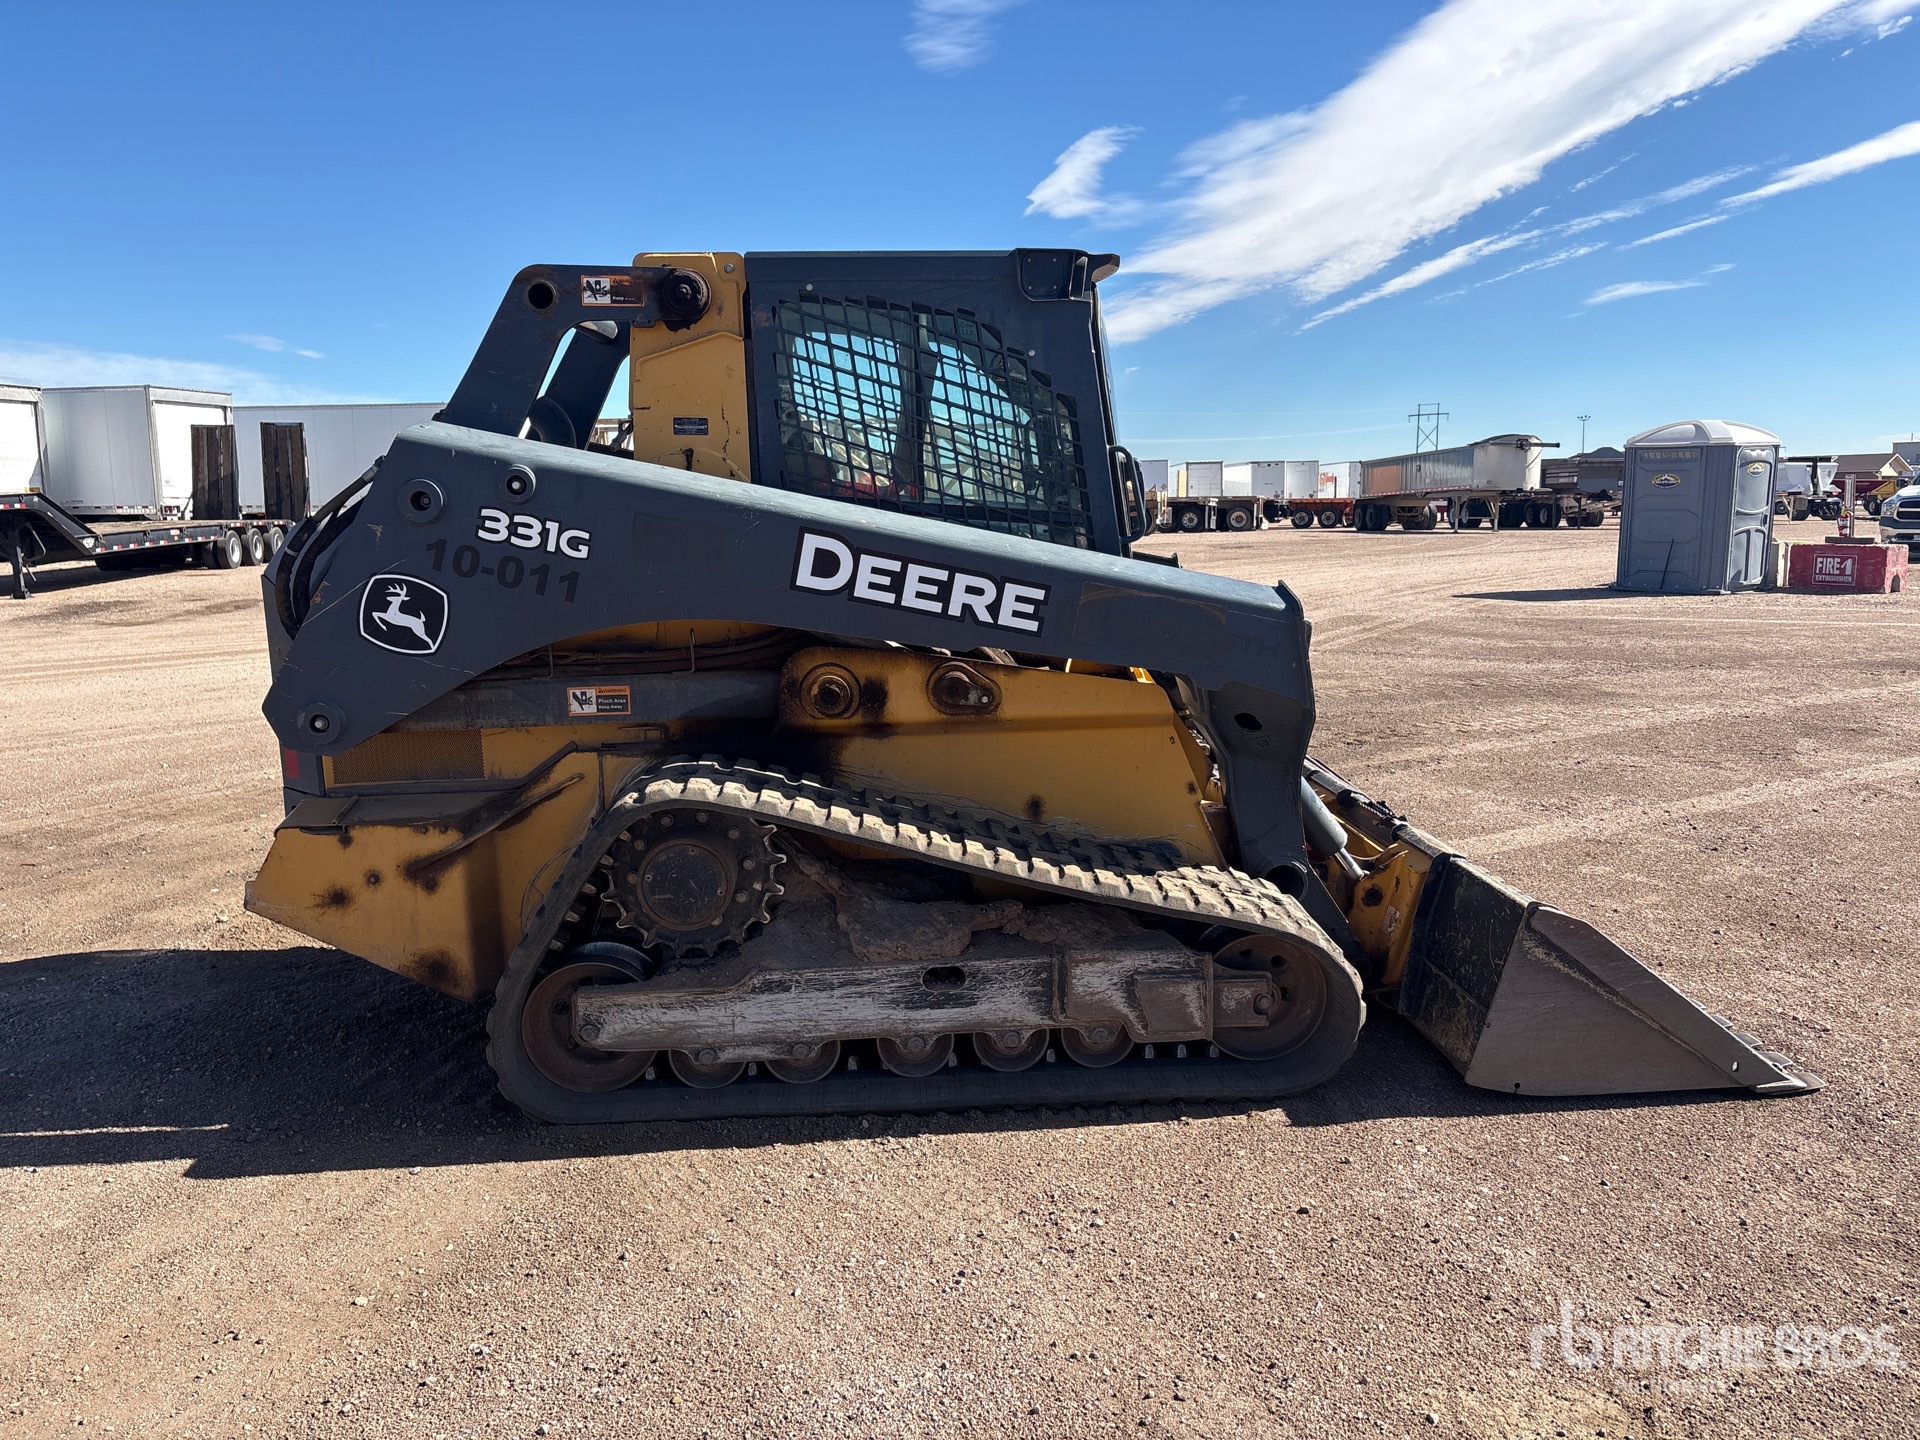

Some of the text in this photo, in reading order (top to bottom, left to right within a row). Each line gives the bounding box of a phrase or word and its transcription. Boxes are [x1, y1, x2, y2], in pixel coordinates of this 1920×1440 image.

[477, 507, 591, 559] 331G
[425, 538, 581, 604] 10-011
[795, 532, 1046, 633] DEERE
[1816, 557, 1840, 574] FIRE
